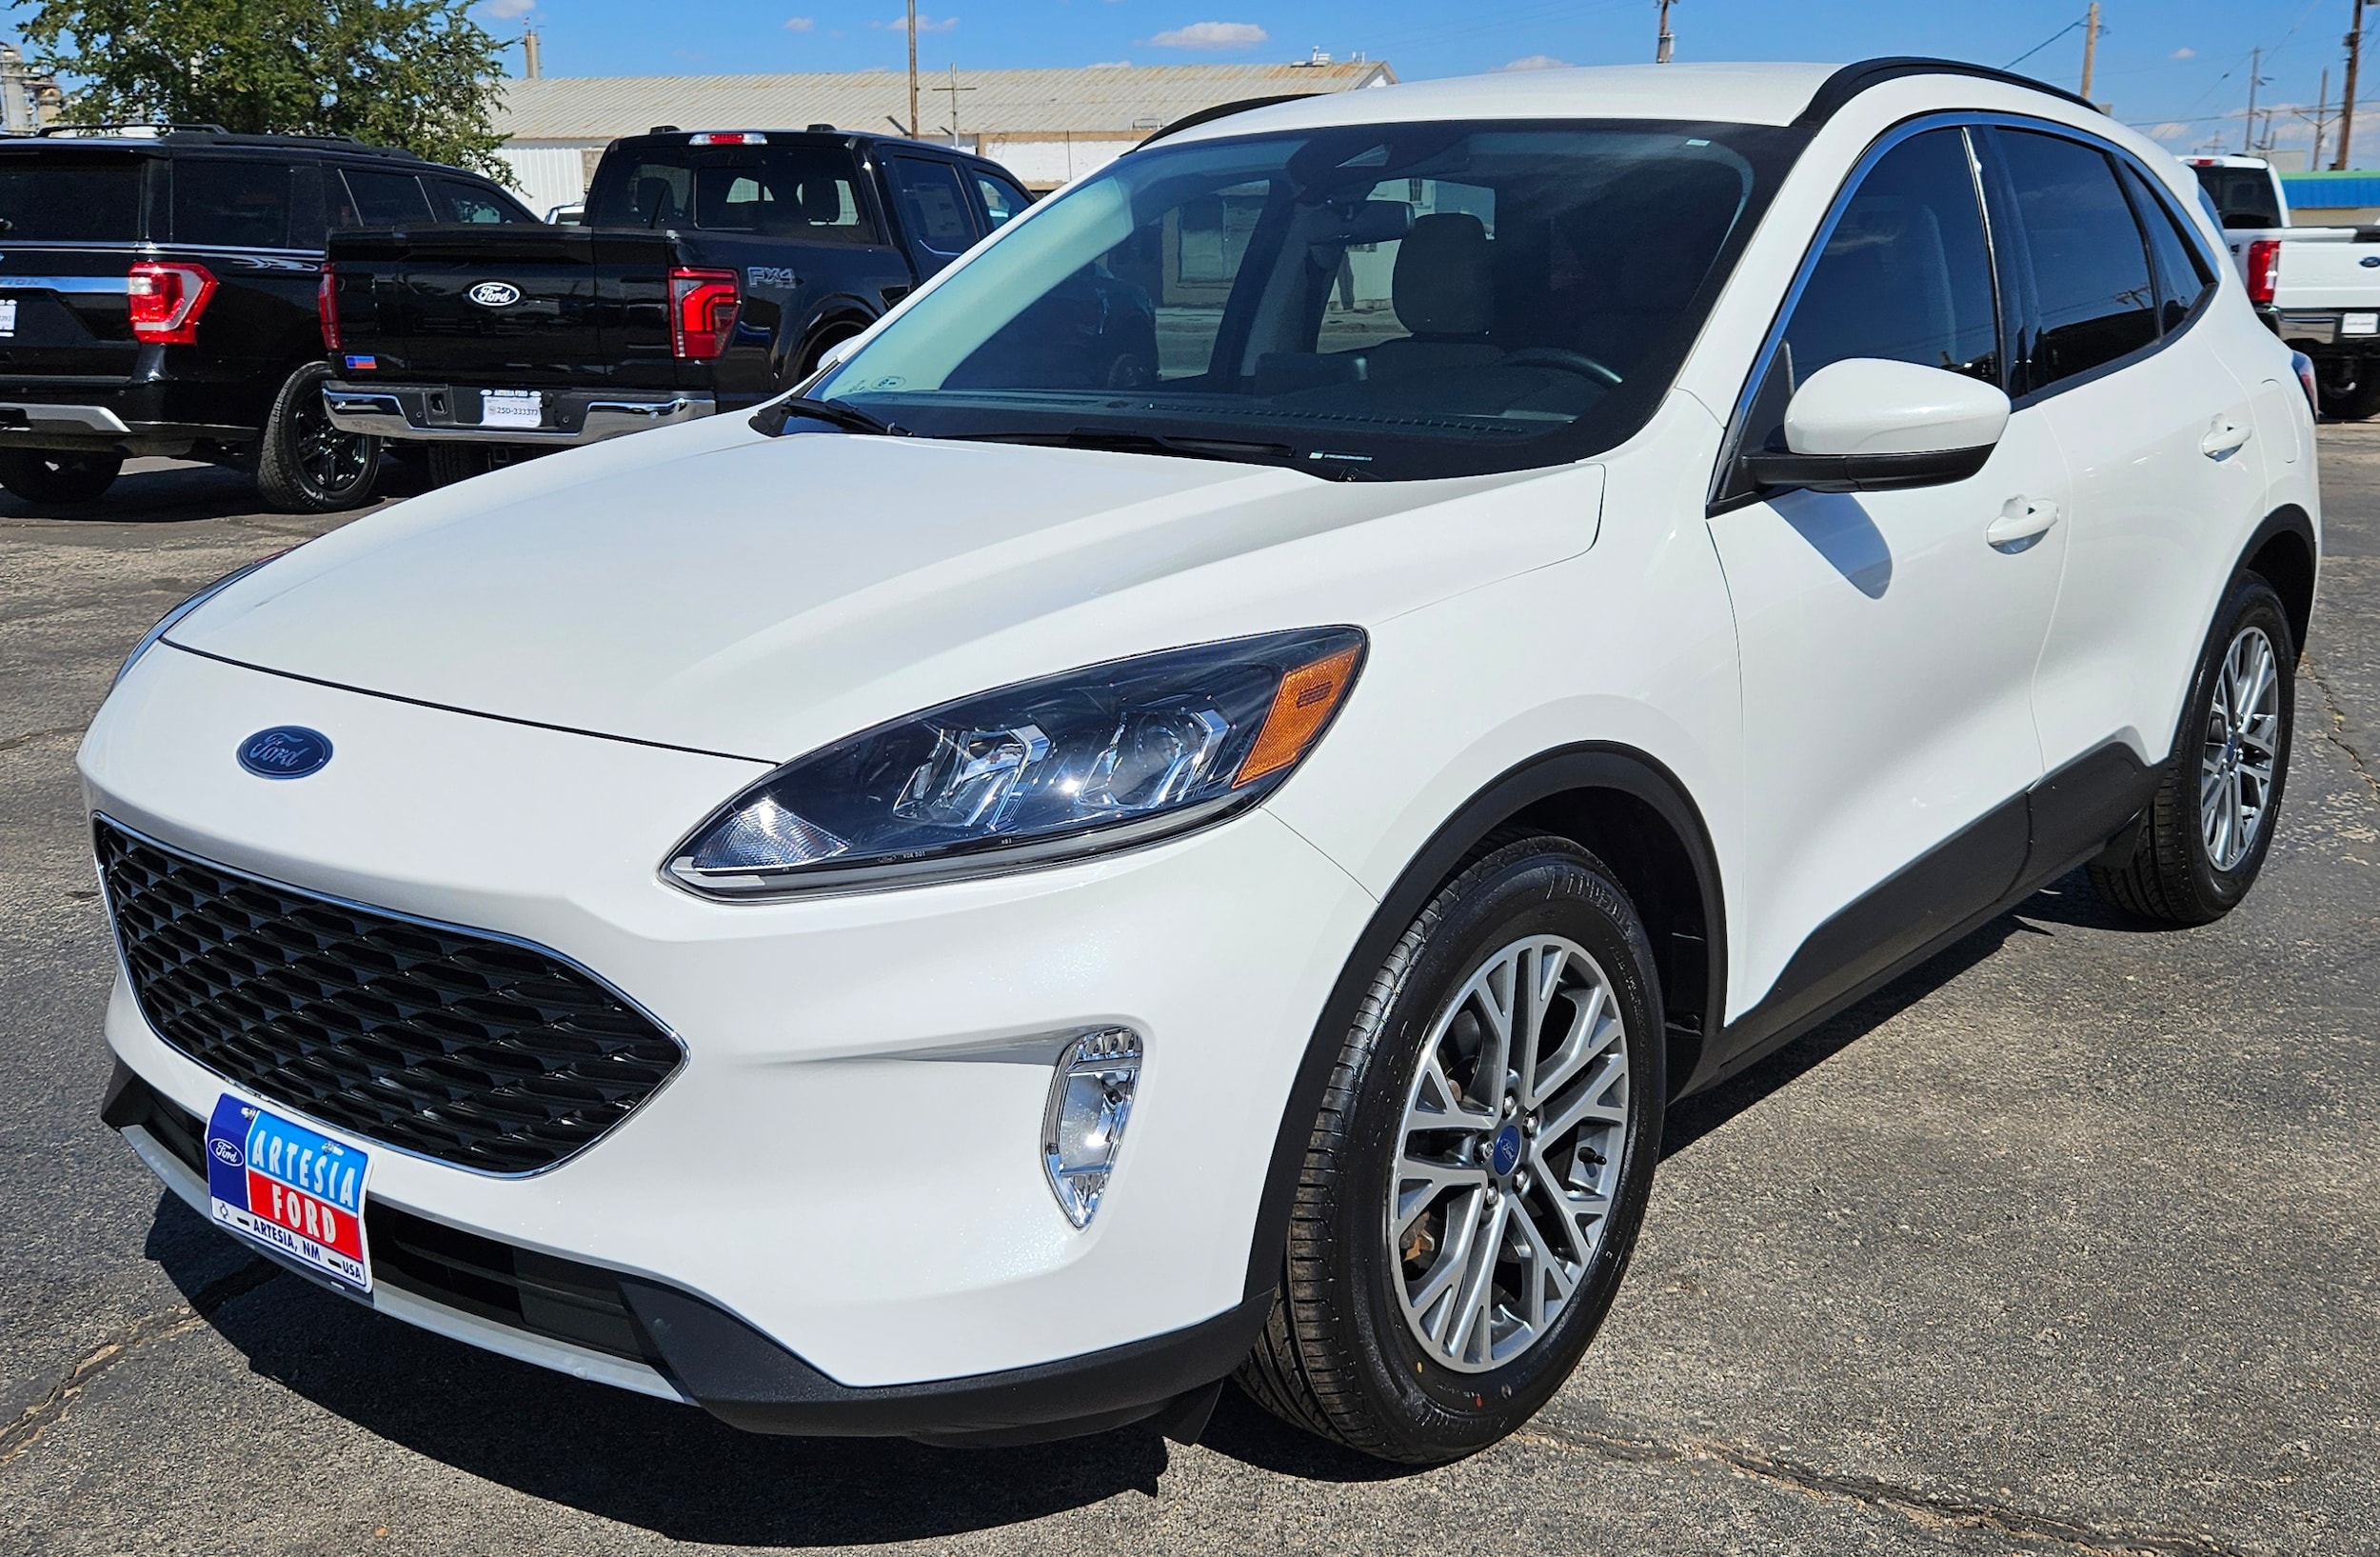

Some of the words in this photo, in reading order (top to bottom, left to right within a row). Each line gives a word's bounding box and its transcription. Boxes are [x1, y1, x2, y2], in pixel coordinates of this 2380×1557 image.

[478, 285, 511, 302] Ford
[747, 267, 793, 288] FX4
[249, 732, 310, 767] Ford
[215, 1141, 238, 1163] Ford
[251, 1130, 356, 1208] ARTESIA
[271, 1183, 337, 1244] FORD
[253, 1220, 299, 1252] ARTESIA,
[302, 1240, 321, 1261] NM
[342, 1260, 362, 1280] USA
